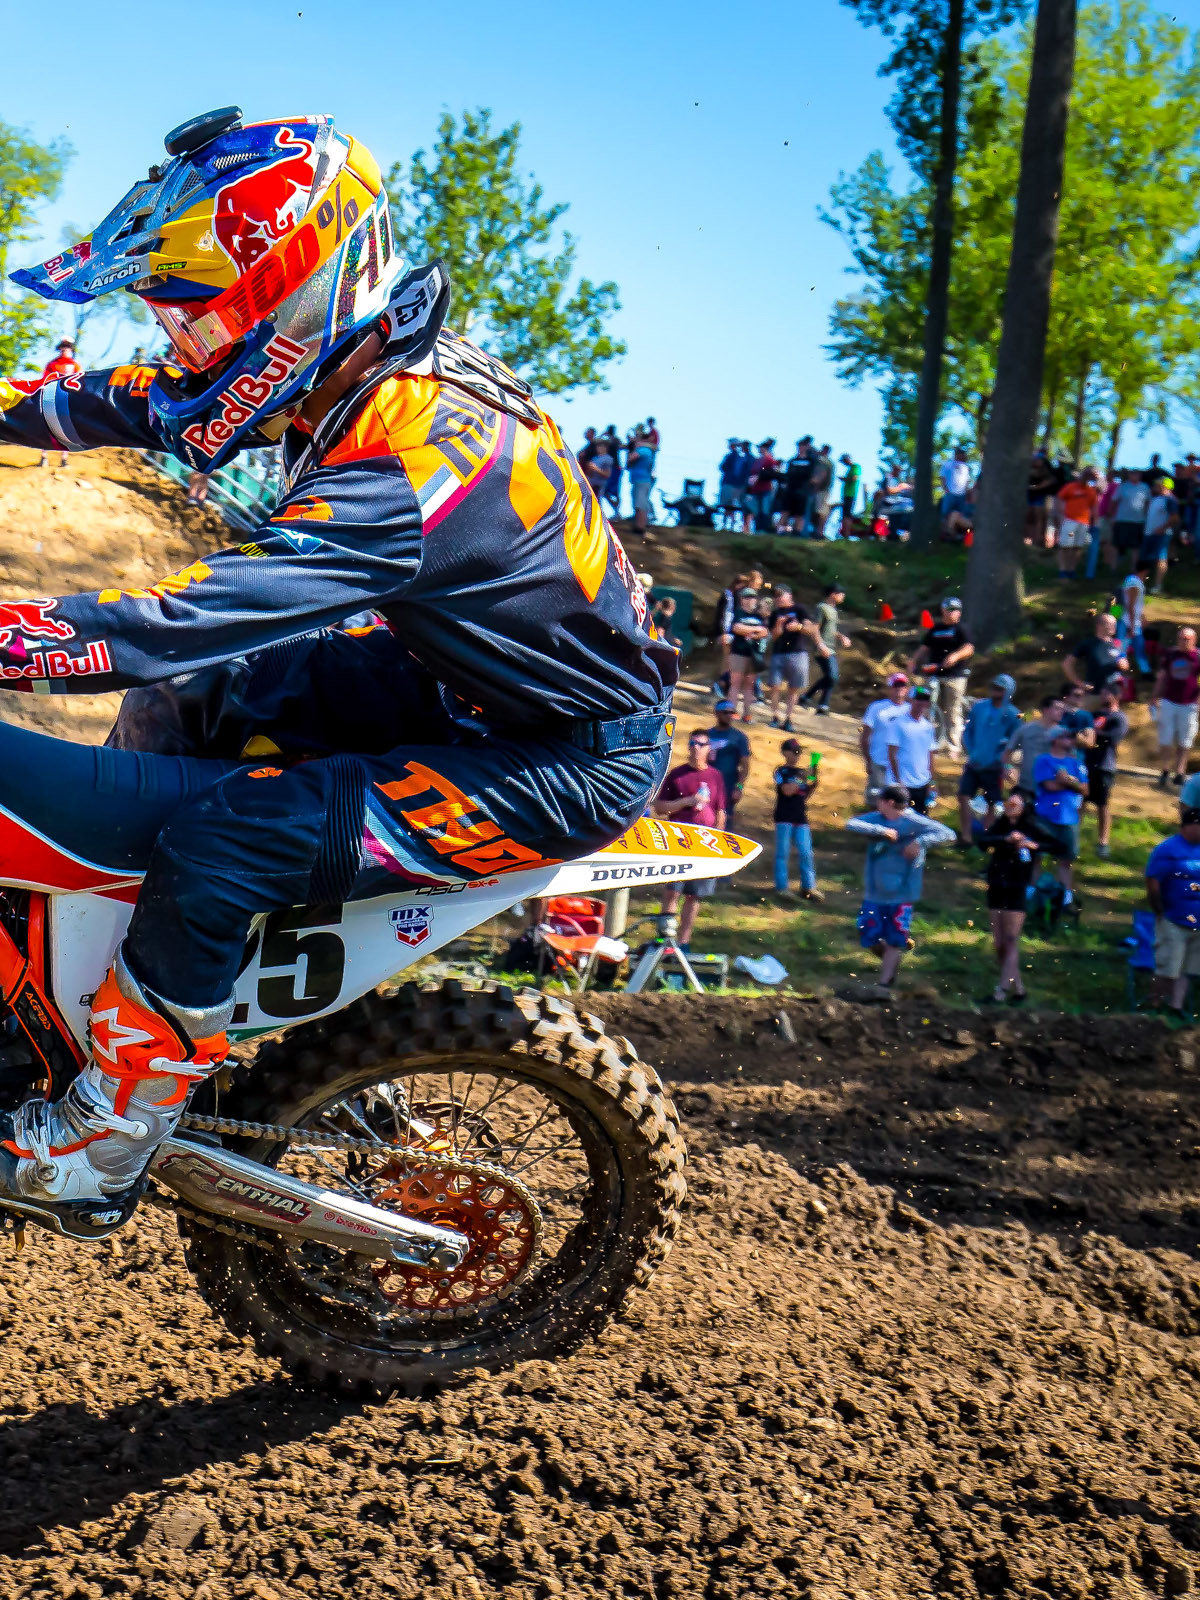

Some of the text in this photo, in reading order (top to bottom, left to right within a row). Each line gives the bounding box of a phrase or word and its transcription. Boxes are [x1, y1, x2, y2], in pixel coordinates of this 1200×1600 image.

[43, 253, 75, 284] Bull
[88, 262, 141, 291] Airoh
[181, 332, 309, 459] Red Bull
[48, 639, 112, 678] Bull
[373, 760, 565, 876] THO
[415, 882, 467, 896] 450
[591, 863, 693, 882] DUNLOP
[231, 903, 346, 1024] 5
[163, 1156, 307, 1217] RENTHAL
[336, 1215, 378, 1236] brembo
